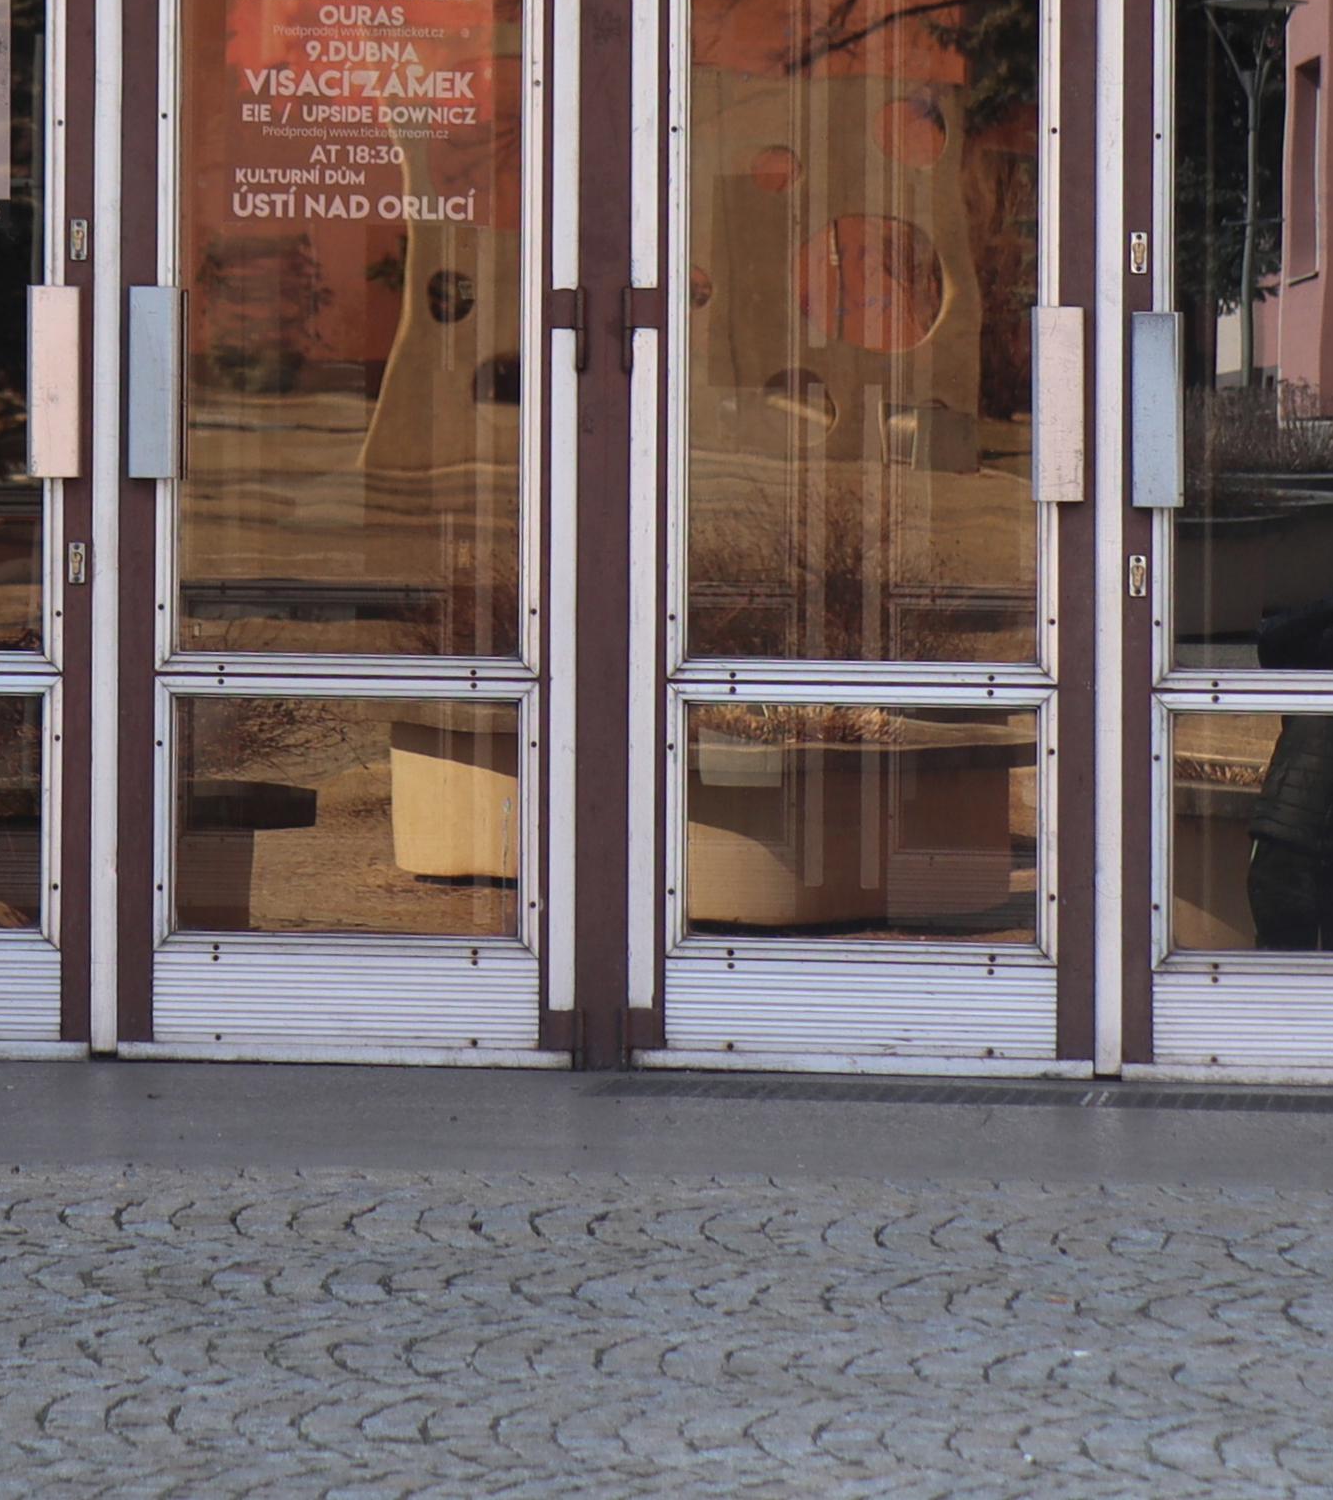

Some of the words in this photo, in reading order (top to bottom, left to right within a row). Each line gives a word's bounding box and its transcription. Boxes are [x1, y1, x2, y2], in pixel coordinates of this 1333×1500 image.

[319, 4, 405, 26] OURAS
[340, 26, 445, 39] www.smsticket.cz
[306, 41, 419, 63] 9.DUBNA
[245, 63, 351, 96] VISACÍ
[361, 64, 475, 98] ZÁMEK
[302, 106, 373, 124] UPSIDE
[262, 126, 327, 140] Předprodej
[329, 126, 449, 140] www.ticketstream.cz
[309, 145, 342, 164] AT
[347, 145, 405, 165] 18:30
[235, 165, 320, 184] KULTURNÍ
[325, 166, 365, 185] DŮM
[233, 186, 297, 218] ÚSTÍ
[305, 193, 370, 220] NAD
[378, 189, 475, 221] ORLICÍ
